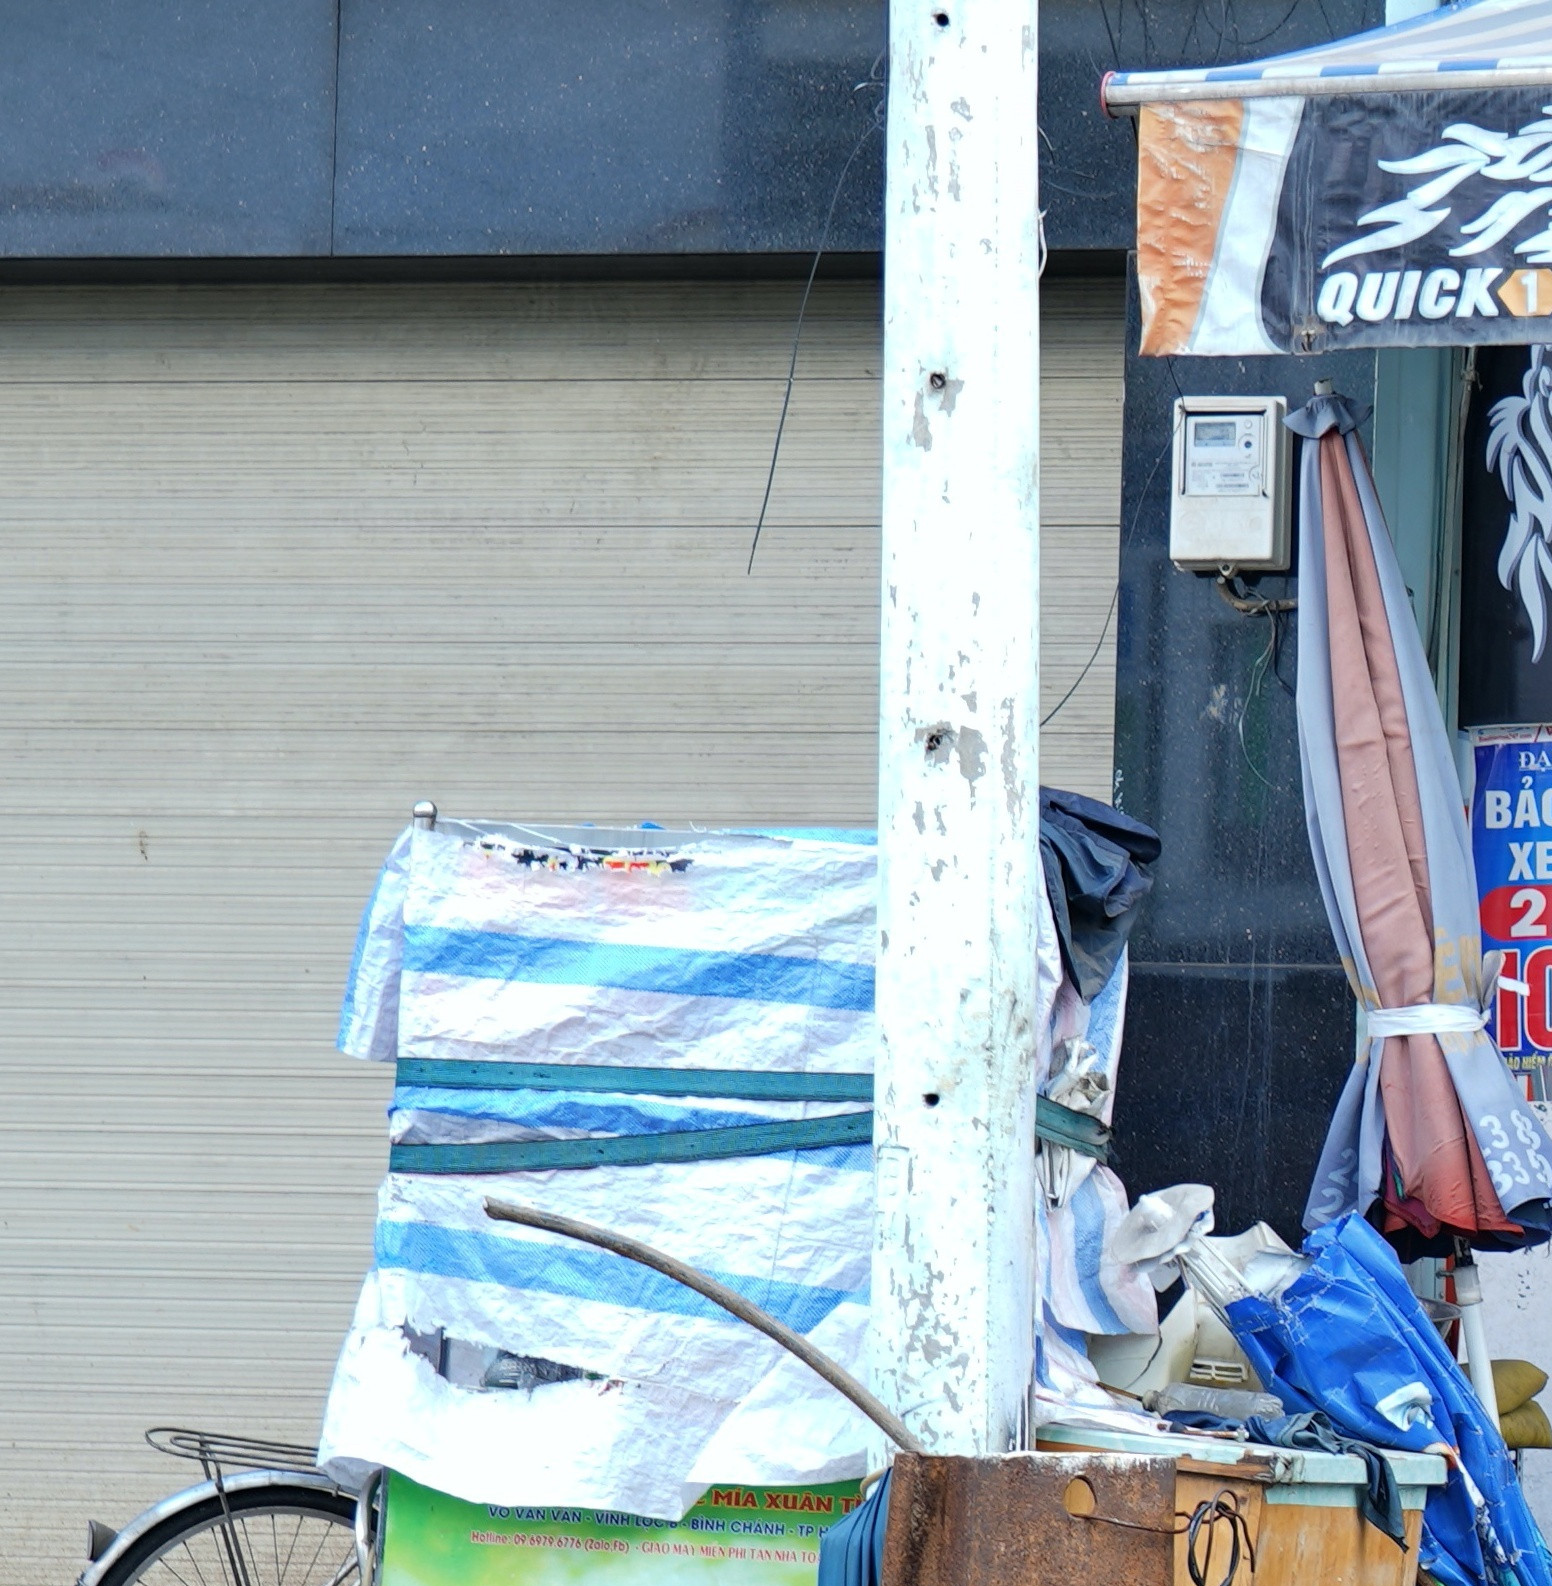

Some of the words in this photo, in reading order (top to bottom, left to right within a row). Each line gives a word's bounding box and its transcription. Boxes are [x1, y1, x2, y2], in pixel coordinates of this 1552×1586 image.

[1317, 268, 1498, 323] QUICK
[1510, 888, 1548, 938] 2
[713, 1489, 757, 1508] MÍA
[765, 1492, 833, 1513] XUÂN
[691, 1516, 725, 1532] BÌNH
[730, 1518, 785, 1536] CHÁNH
[798, 1525, 814, 1537] TP
[471, 1530, 511, 1545] Hotline:
[642, 1541, 669, 1555] GIAO
